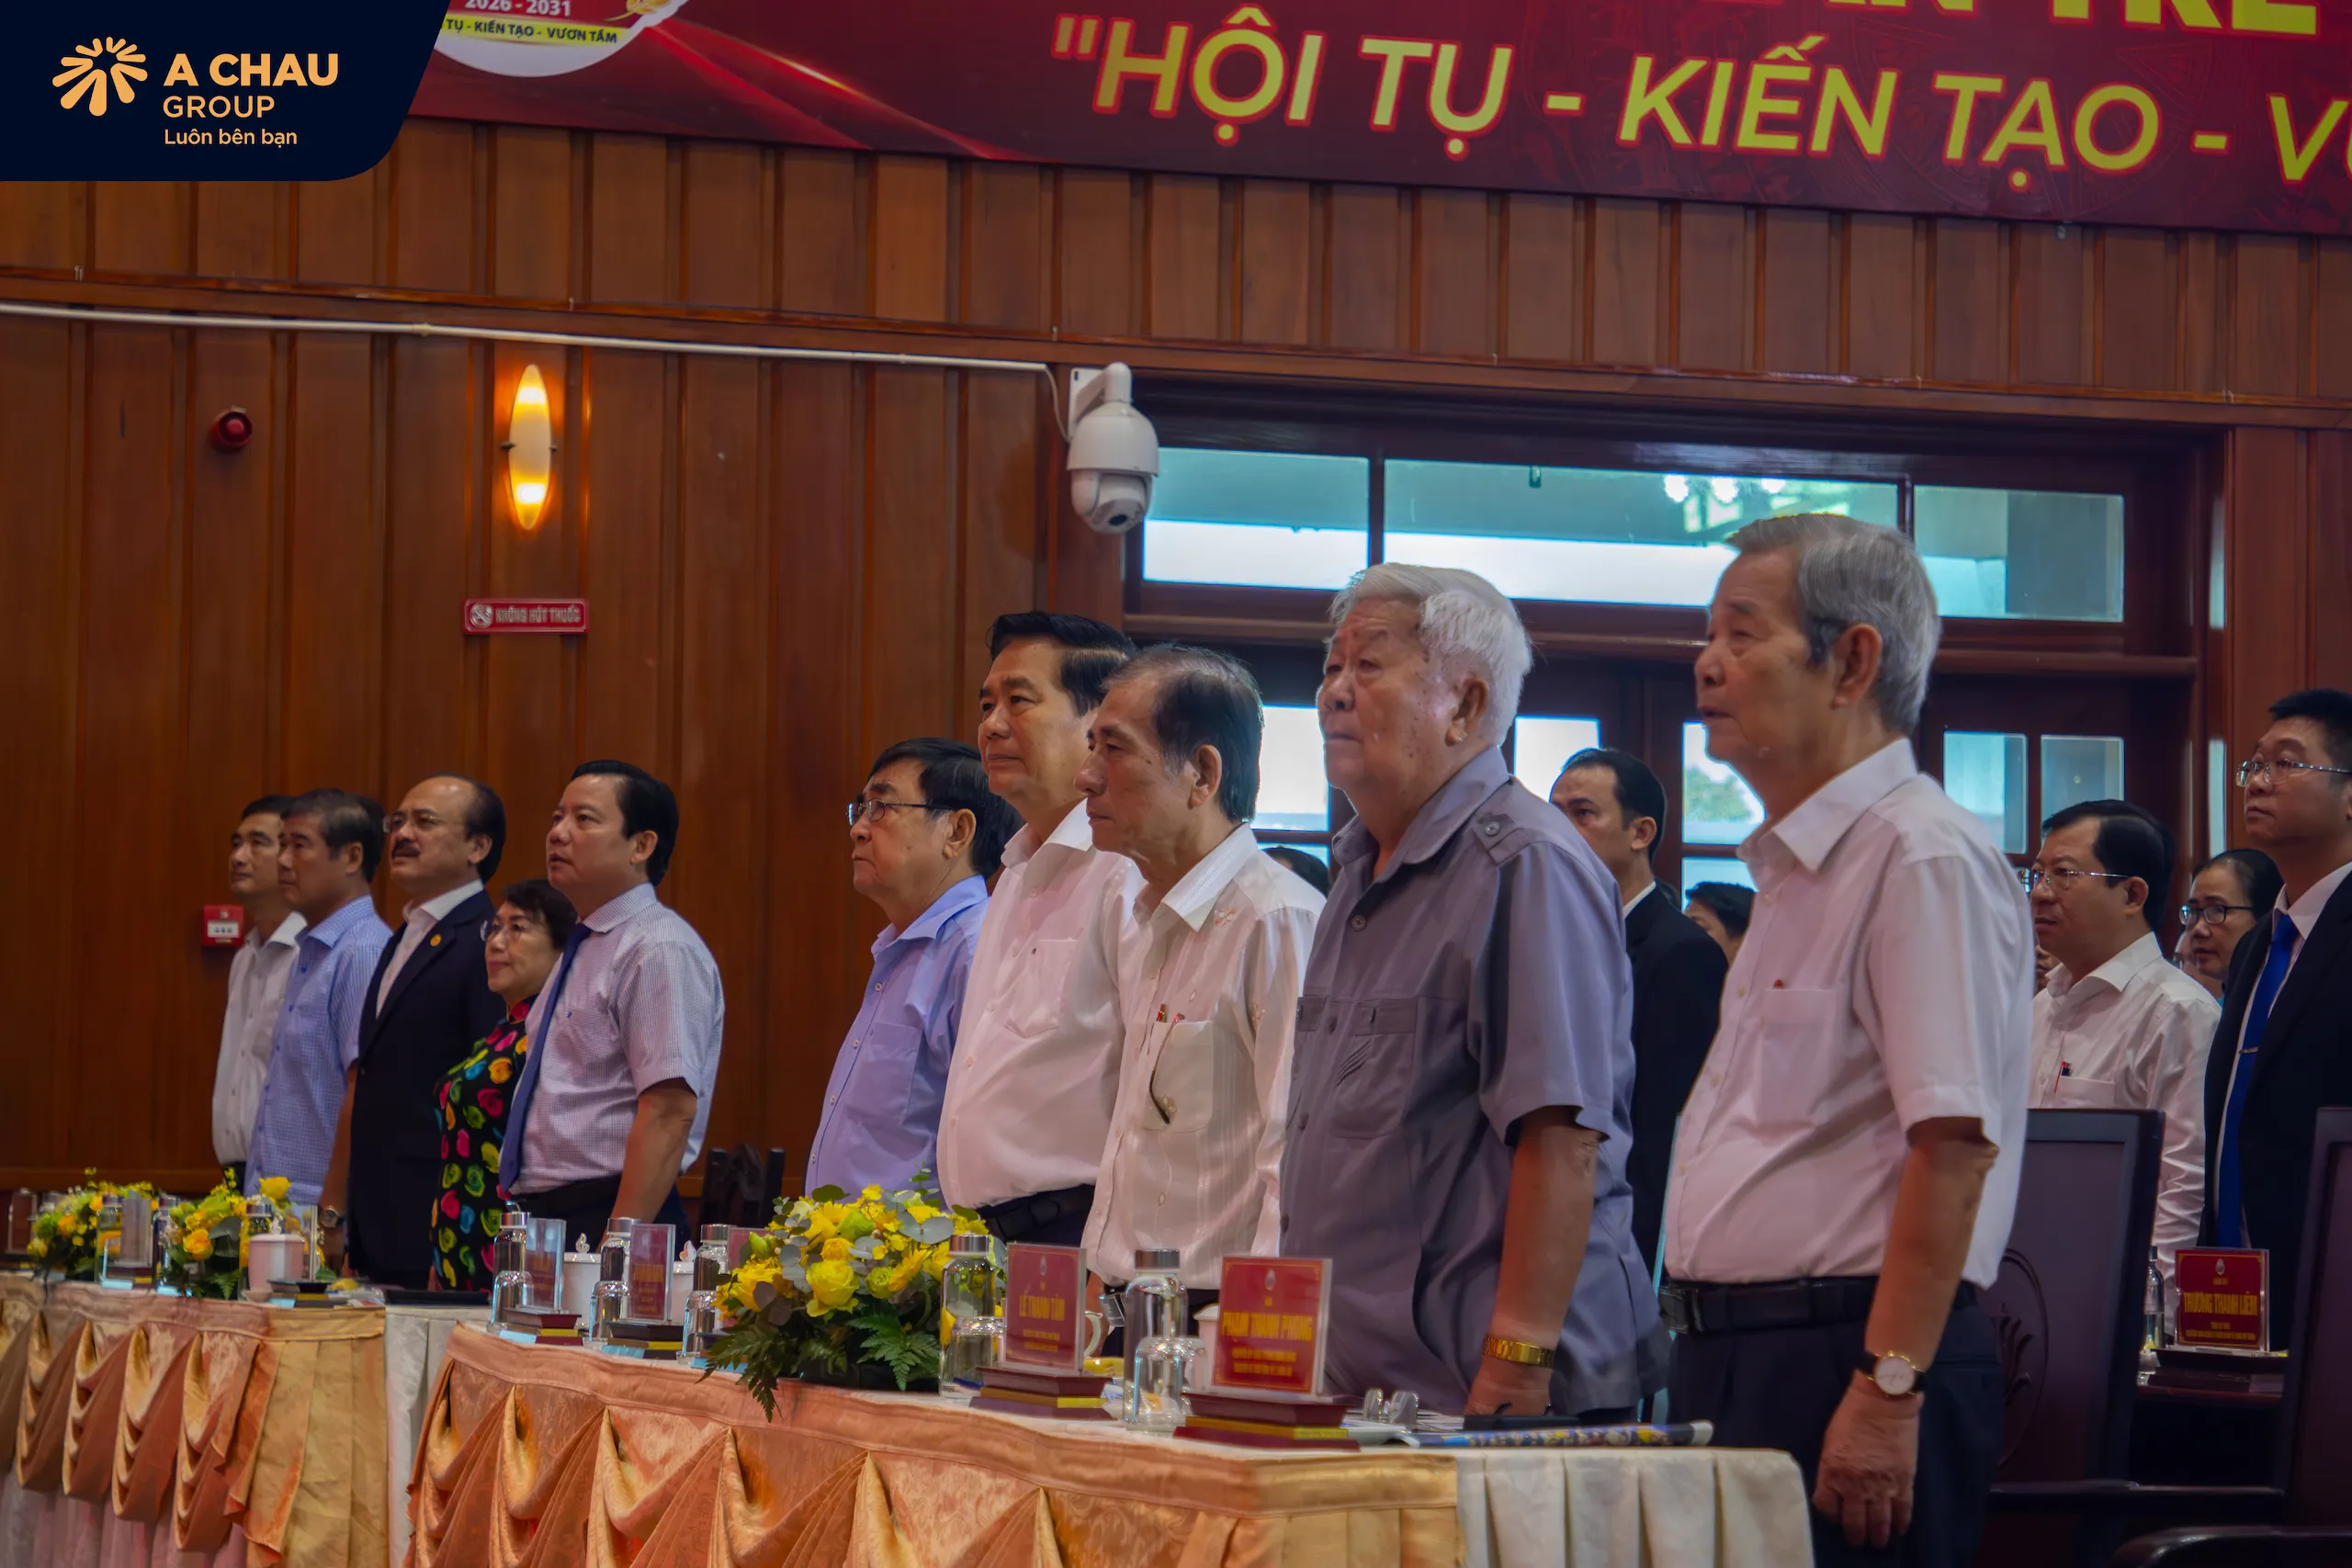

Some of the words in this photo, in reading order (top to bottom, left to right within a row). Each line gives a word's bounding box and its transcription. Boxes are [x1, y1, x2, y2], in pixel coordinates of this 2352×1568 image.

[526, 0, 571, 17] 2031
[447, 18, 464, 33] TỤ
[507, 24, 534, 39] TẠO
[547, 28, 586, 41] VƯƠN
[1053, 5, 1325, 143] "HỘI
[1361, 37, 1513, 157] TỤ
[1544, 93, 1583, 112] -
[1619, 35, 1899, 156] KIẾN
[1934, 74, 2160, 188] TẠO
[2193, 133, 2228, 151] -
[2268, 95, 2352, 182] V
